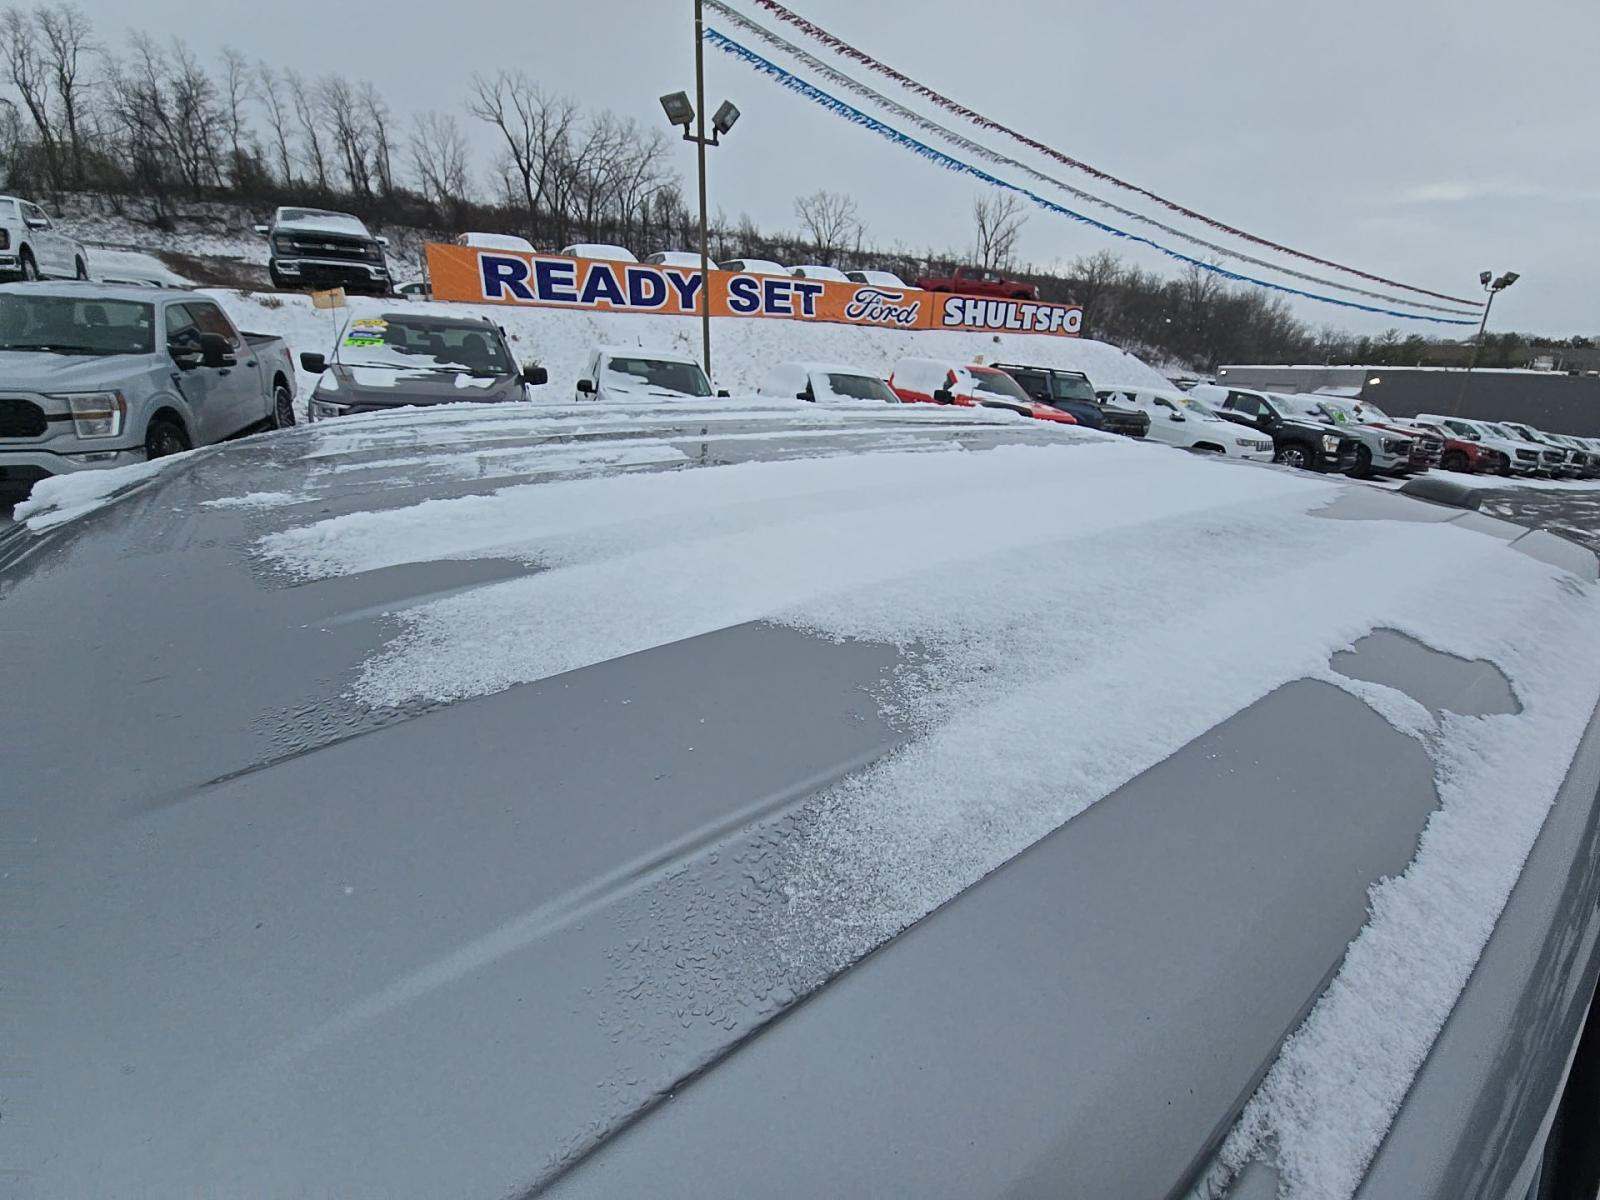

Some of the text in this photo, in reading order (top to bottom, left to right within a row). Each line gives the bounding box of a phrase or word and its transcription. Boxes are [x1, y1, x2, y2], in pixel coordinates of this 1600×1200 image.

[479, 254, 920, 327] READY SET Ford
[943, 296, 1083, 334] SHULTSFO
